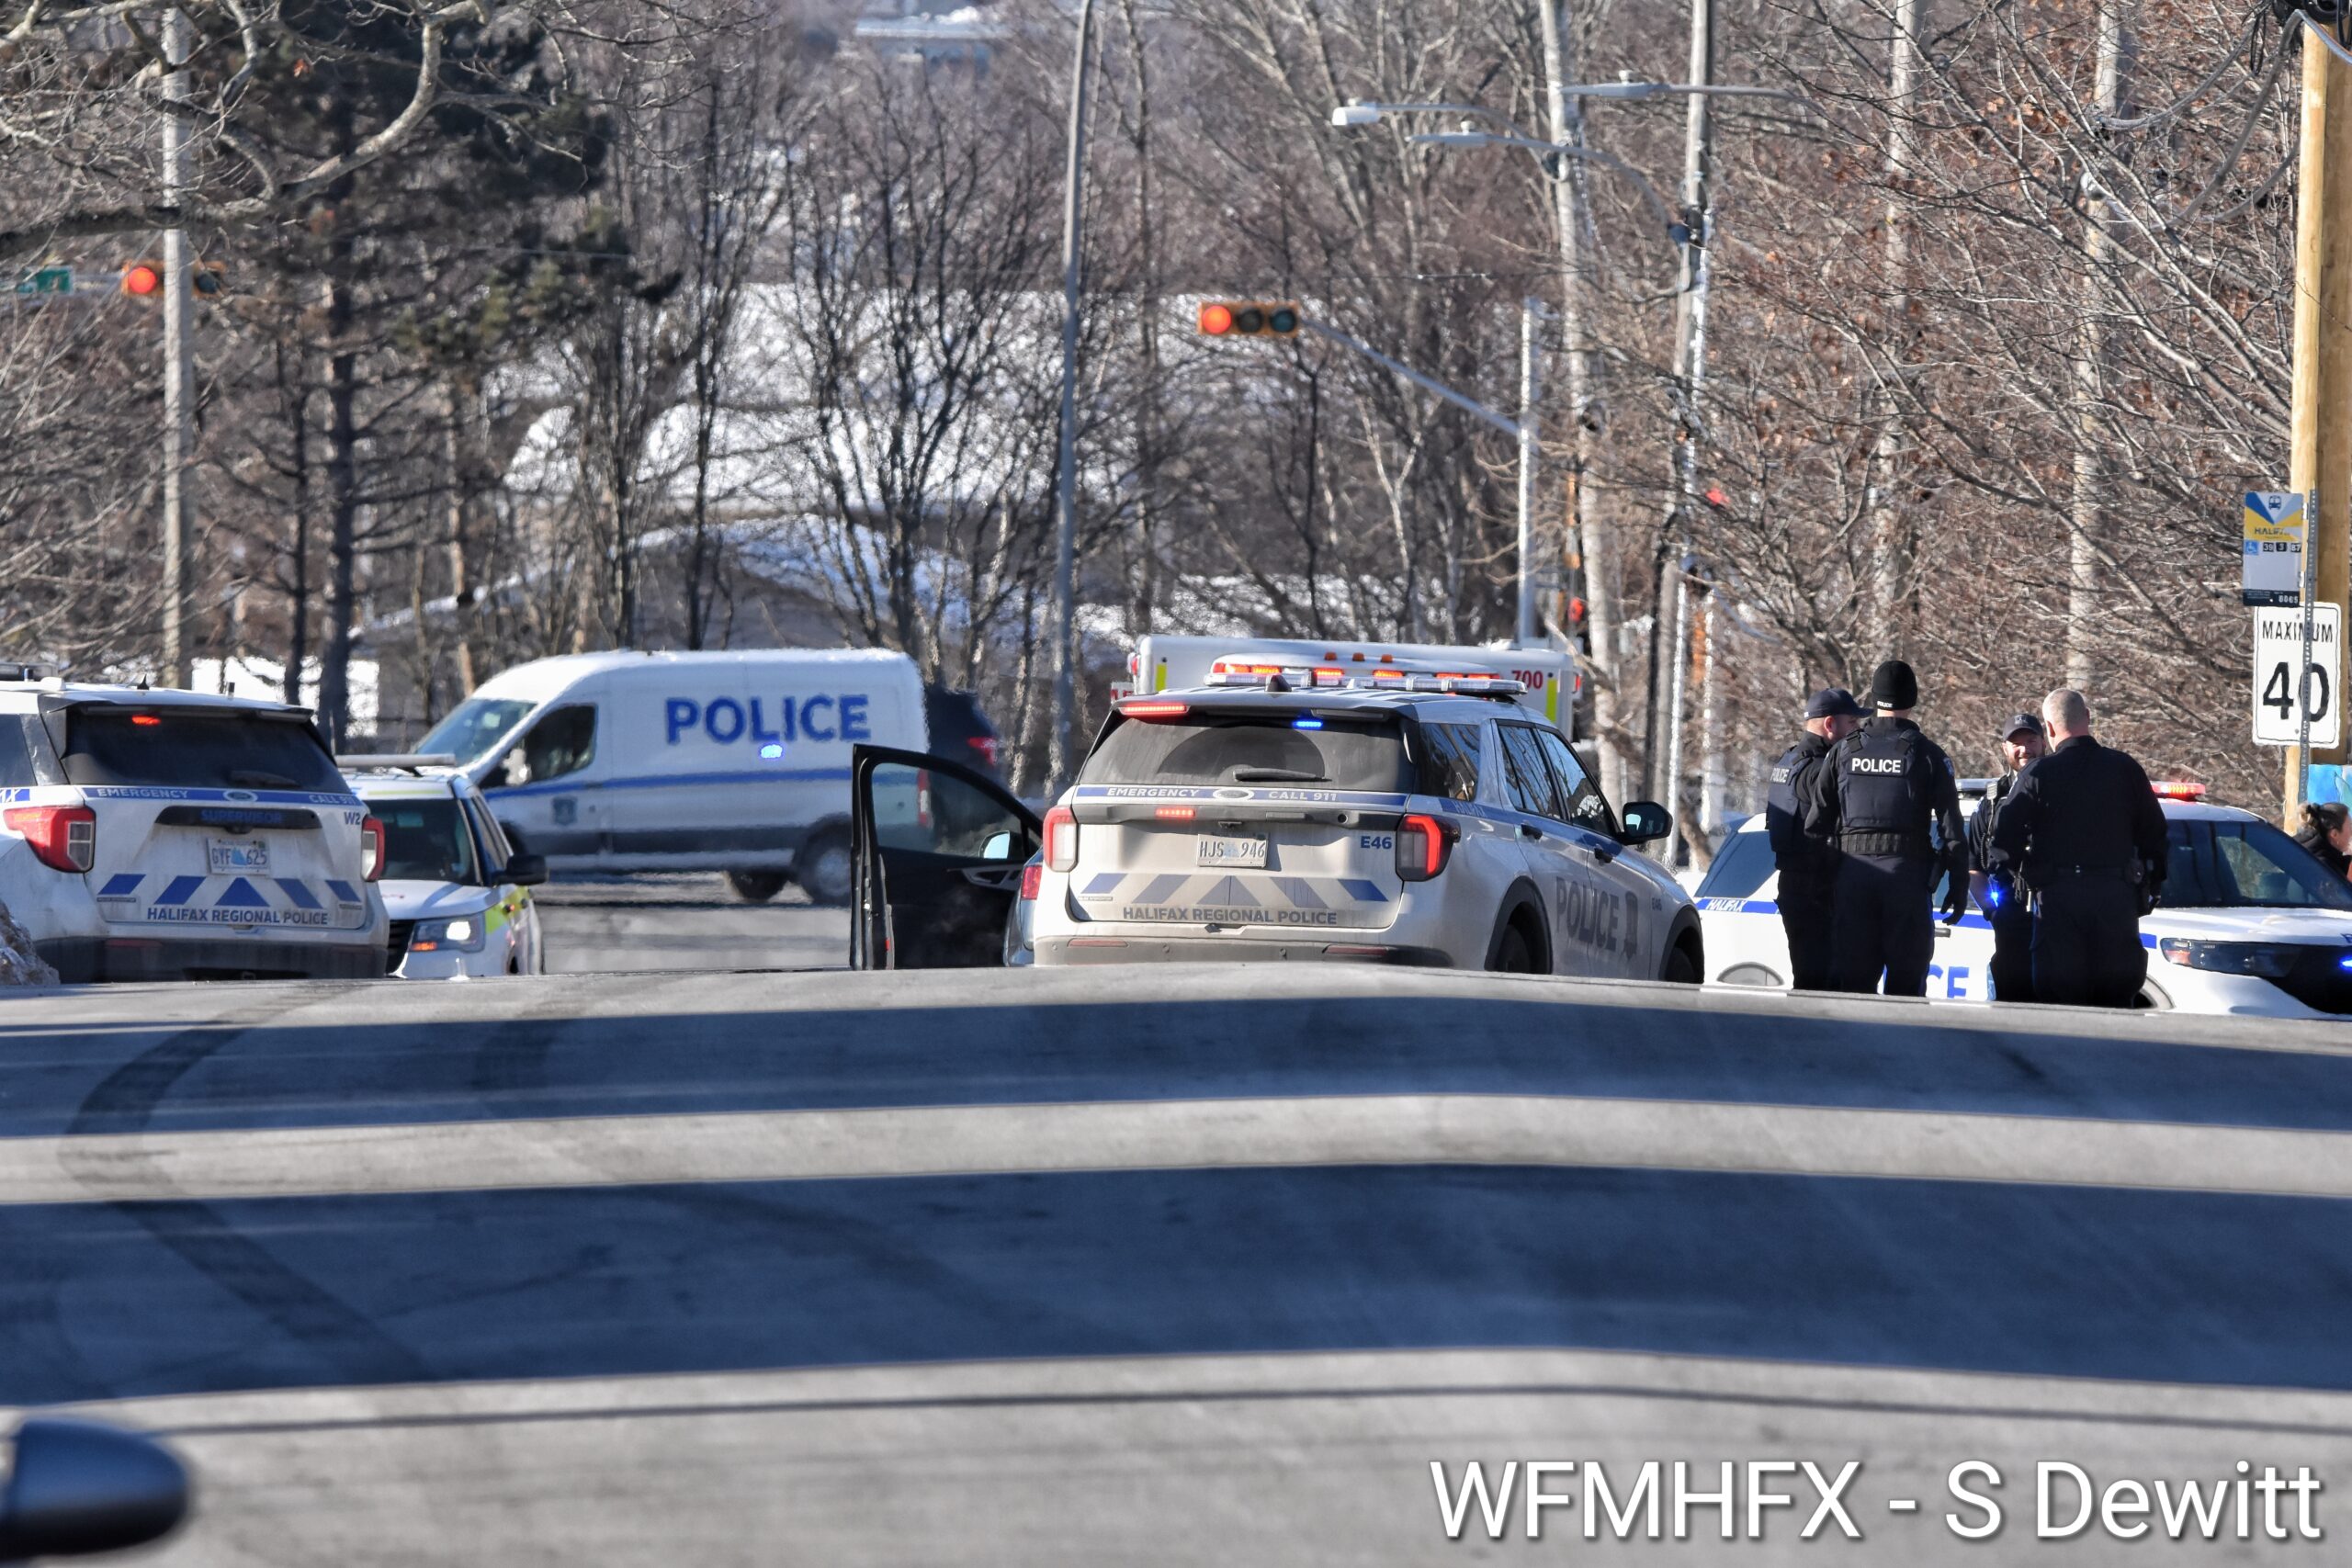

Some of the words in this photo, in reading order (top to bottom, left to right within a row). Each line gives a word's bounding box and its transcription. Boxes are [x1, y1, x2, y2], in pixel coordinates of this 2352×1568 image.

[2264, 543, 2274, 551] 39
[2263, 661, 2330, 723] 40
[665, 694, 872, 745] POLICE
[1851, 758, 1902, 773] POLICE
[96, 788, 188, 799] EMERGENCY
[309, 794, 340, 805] CALL
[1106, 787, 1200, 798] EMERGENCY
[1268, 791, 1309, 801] CALL
[1313, 792, 1338, 802] 911
[200, 809, 283, 824] SUPERVISOR
[344, 812, 361, 825] W2
[1199, 840, 1225, 858] HJS
[1240, 841, 1266, 859] 946
[1361, 835, 1393, 850] E46
[212, 848, 232, 864] GYF
[246, 849, 267, 865] 625
[1705, 899, 1747, 913] HALIFAX
[147, 907, 209, 921] HALIFAX
[212, 908, 279, 924] REGIONAL
[284, 911, 328, 926] POLICE
[1123, 907, 1188, 920] HALIFAX
[1193, 908, 1274, 923] REGIONAL
[1277, 910, 1338, 925] POLICE
[1555, 875, 1620, 953] POLICE
